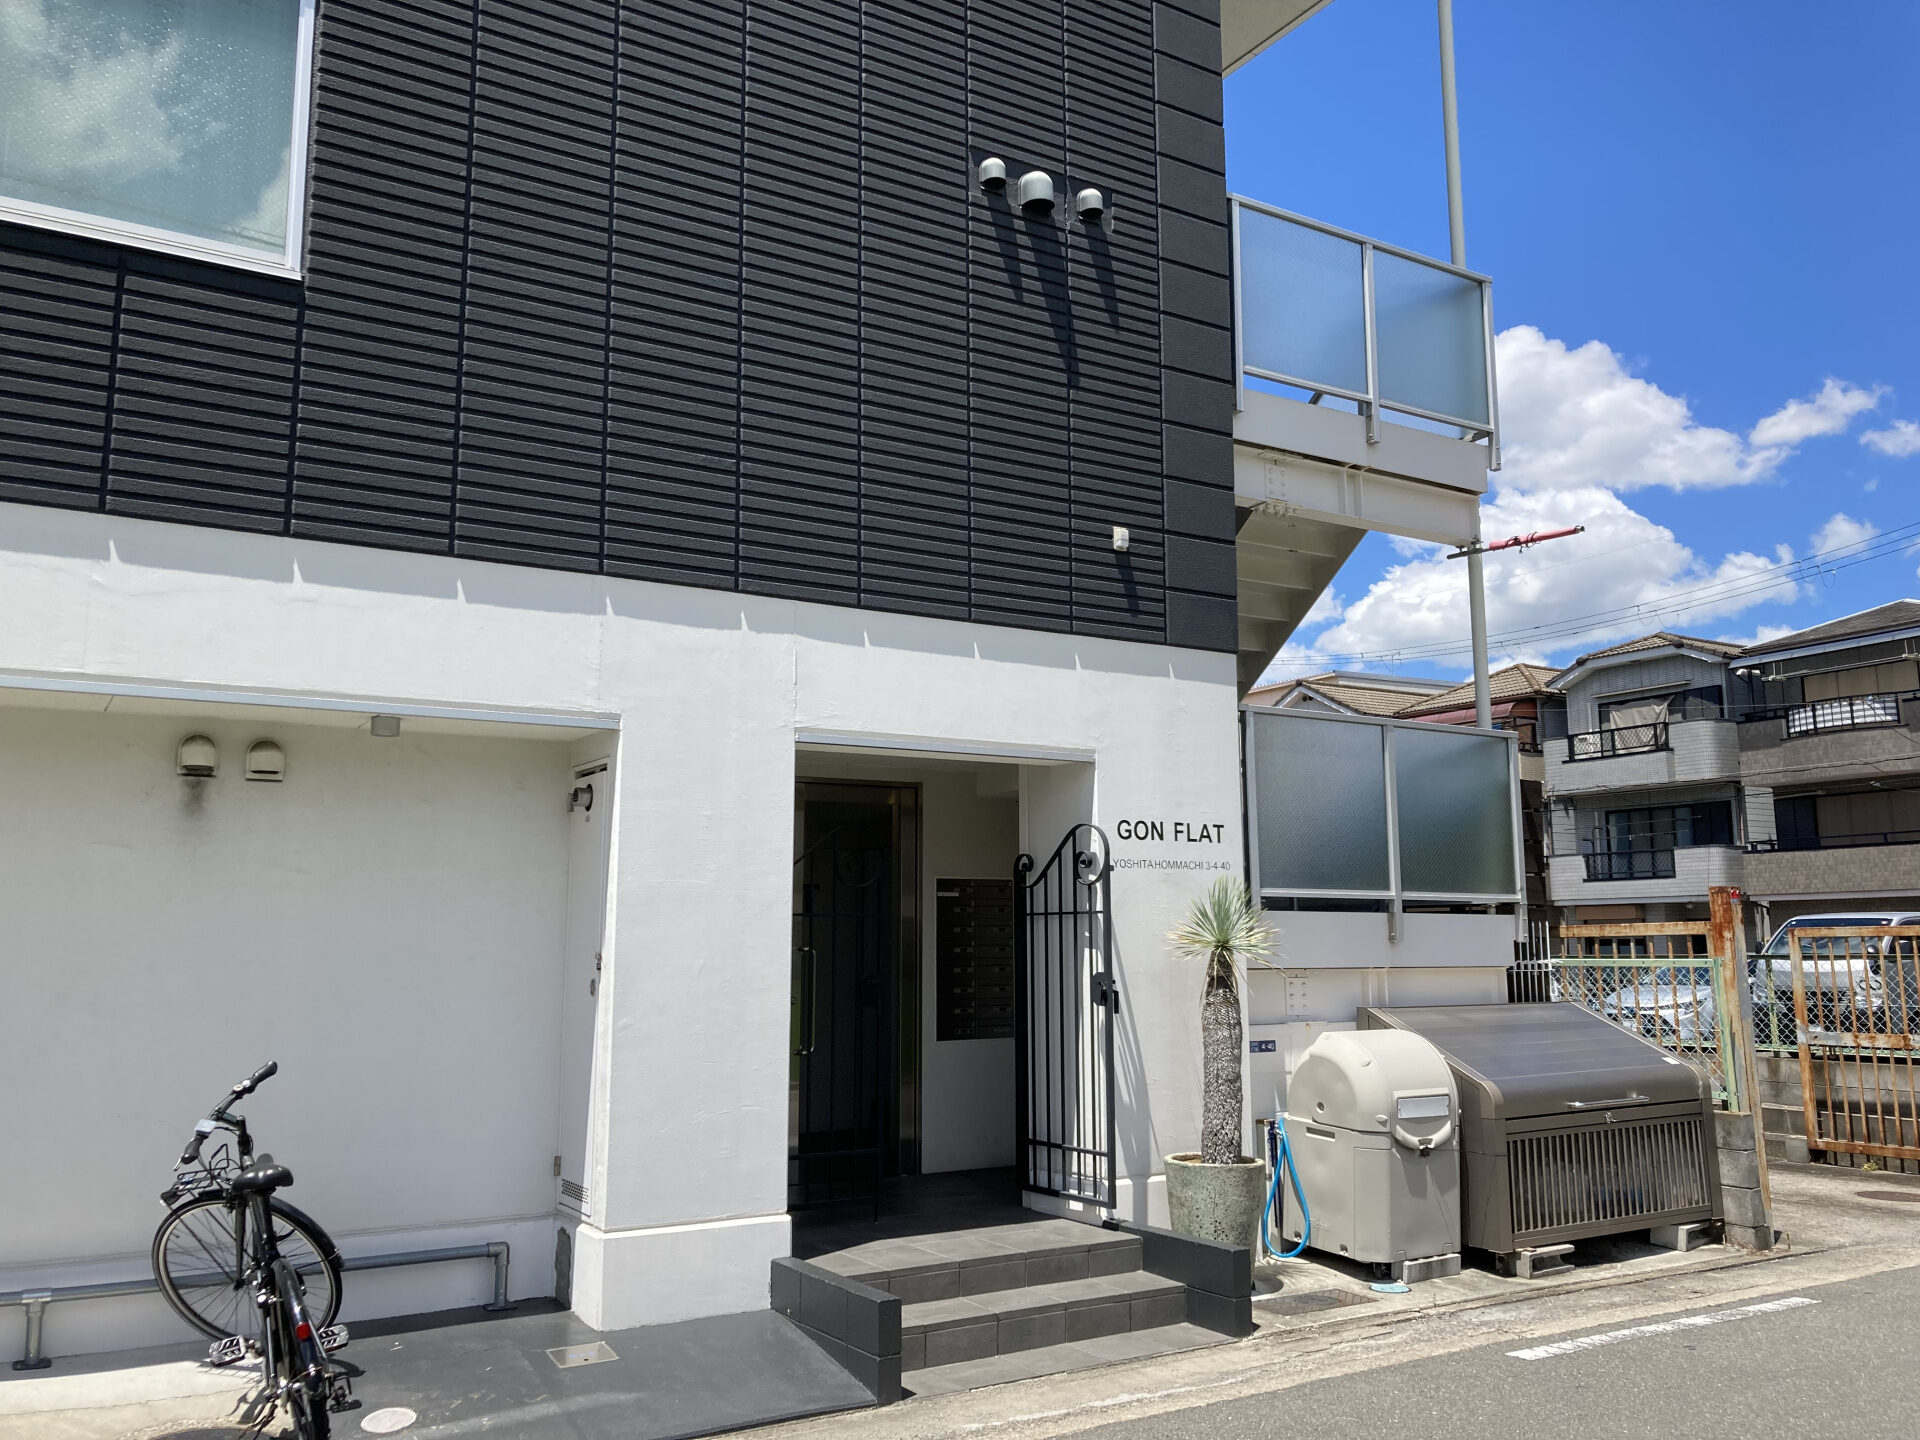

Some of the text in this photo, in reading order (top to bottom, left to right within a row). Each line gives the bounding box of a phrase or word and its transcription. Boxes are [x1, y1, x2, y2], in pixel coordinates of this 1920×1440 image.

[1117, 820, 1225, 844] GON FLAT
[1205, 860, 1231, 871] 3-4-40
